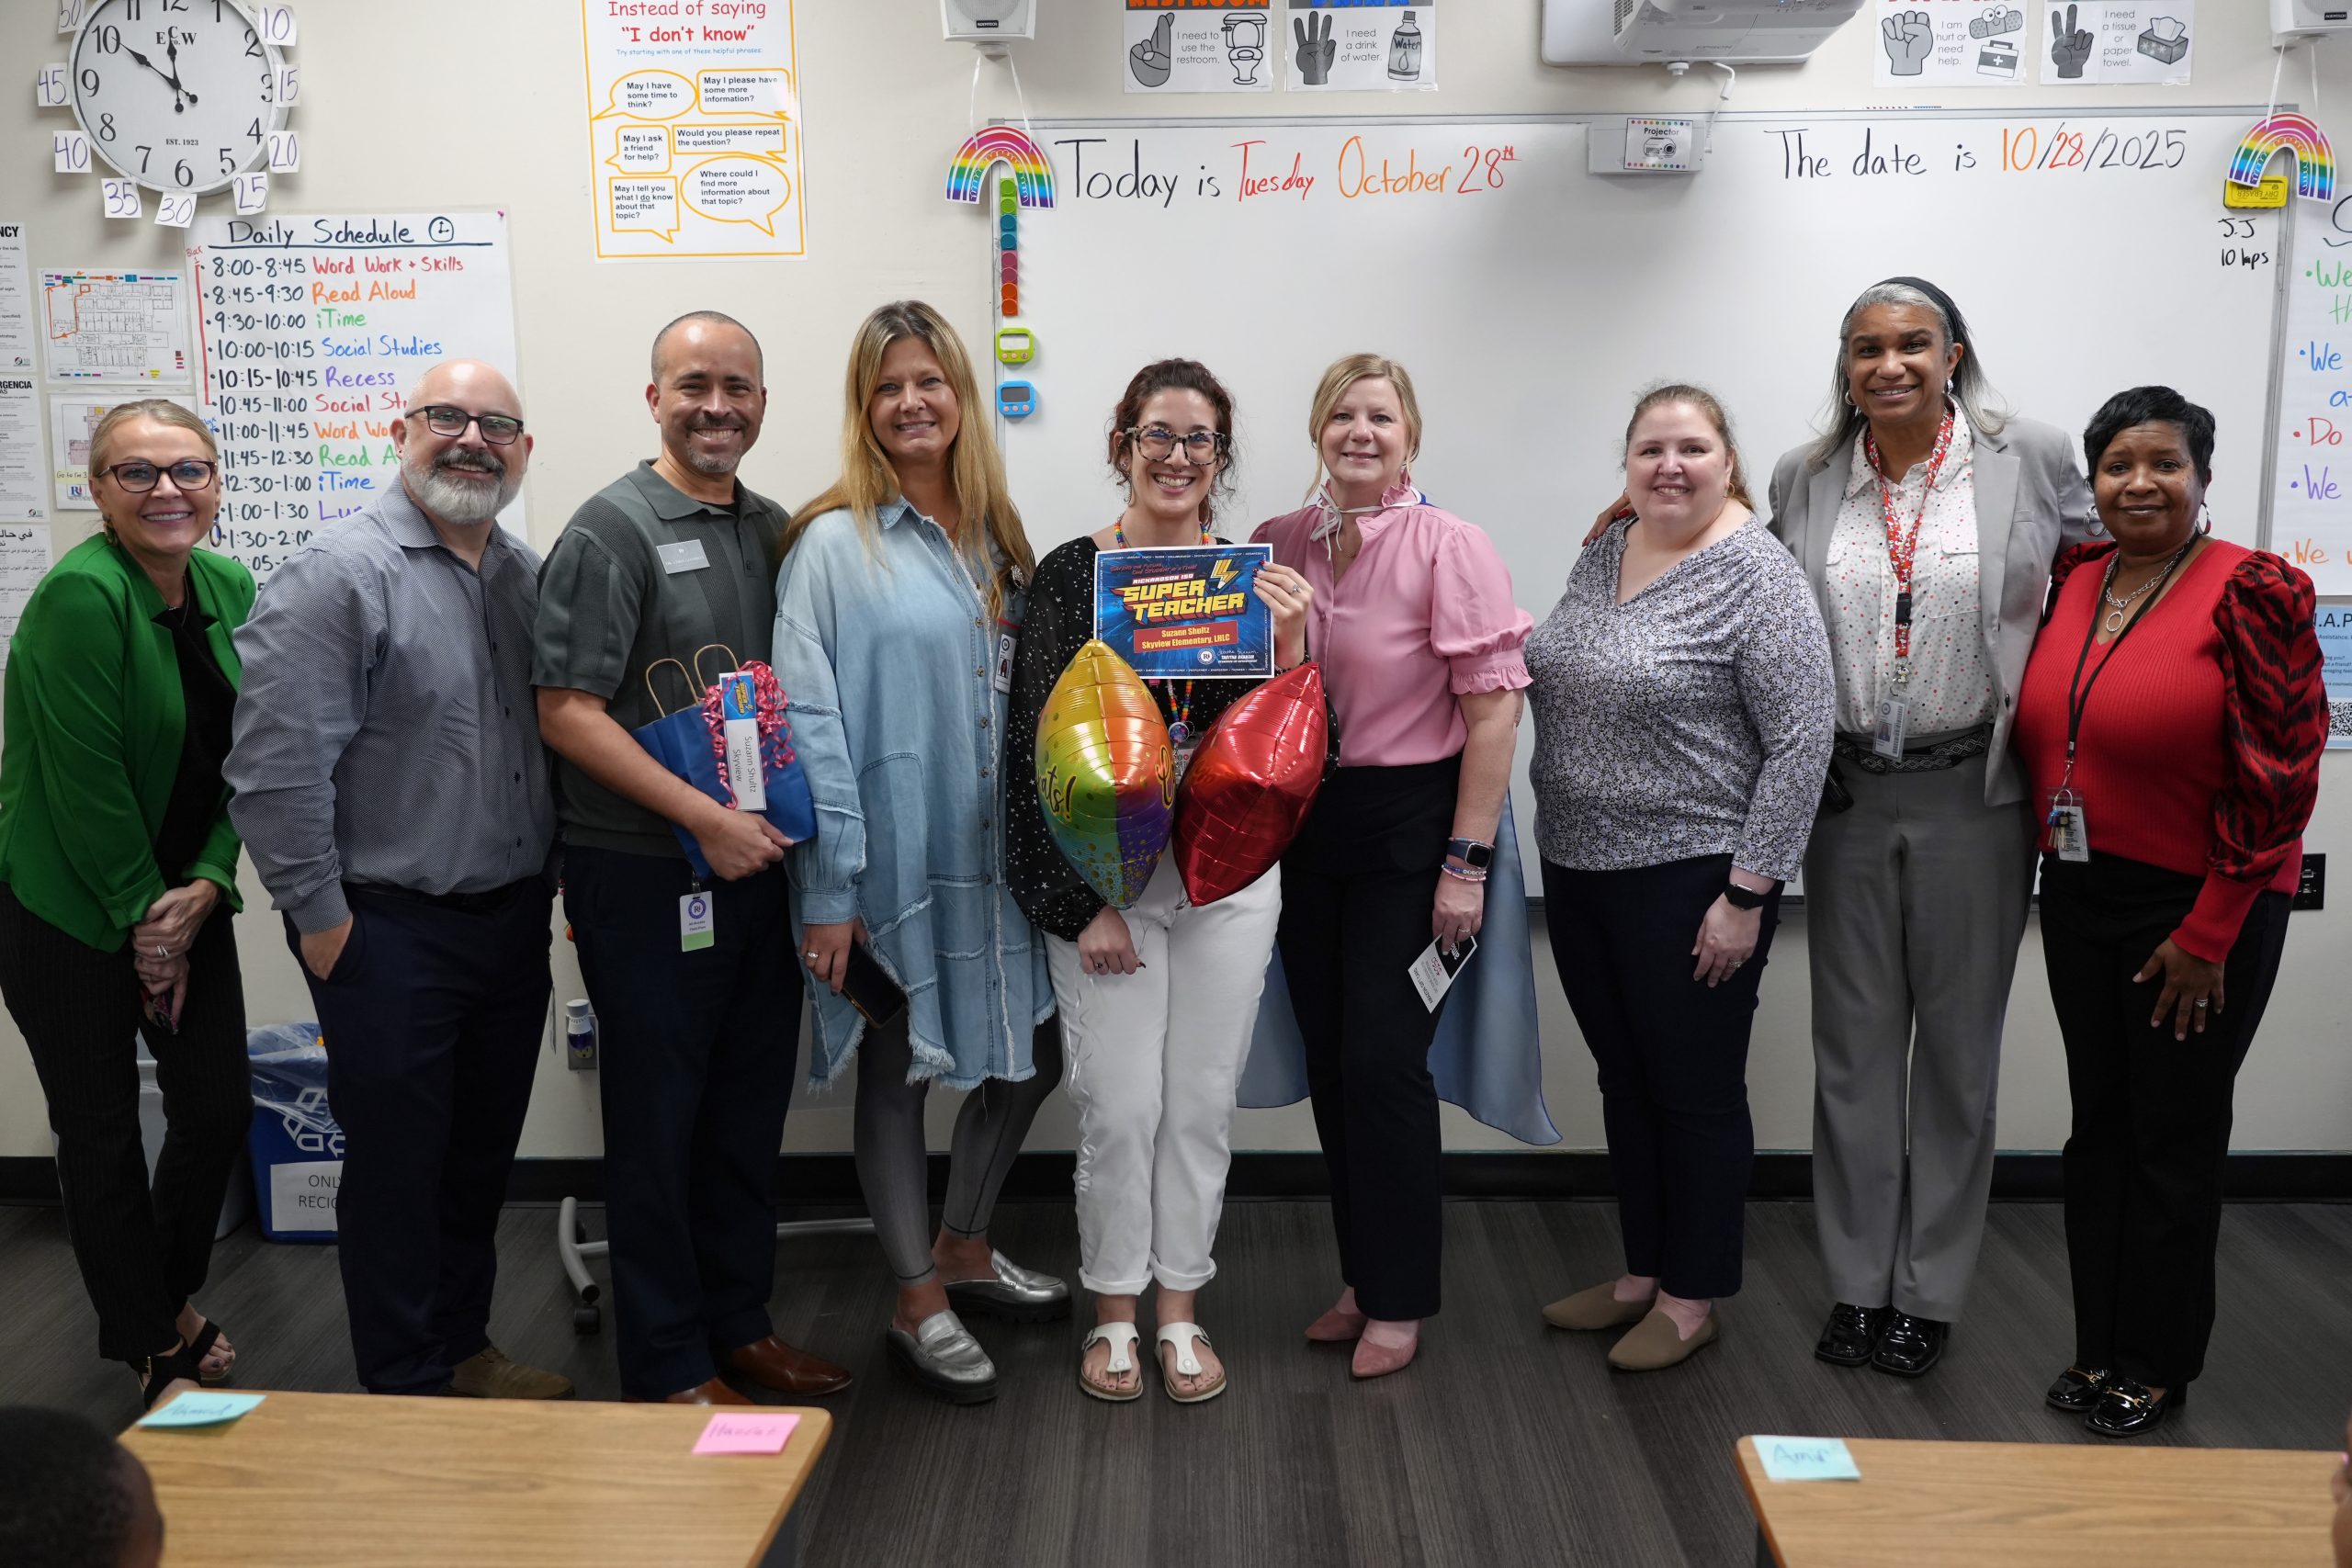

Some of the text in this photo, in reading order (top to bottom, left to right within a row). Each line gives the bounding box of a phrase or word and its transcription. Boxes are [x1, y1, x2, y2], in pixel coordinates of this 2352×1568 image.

[608, 0, 766, 18] Instead of saying
[2110, 10, 2135, 19] need
[264, 7, 290, 40] 10
[1351, 28, 1377, 38] need
[2112, 22, 2137, 31] tissue
[92, 25, 121, 54] 10
[244, 28, 264, 58] 2
[650, 26, 695, 42] don't
[1182, 31, 1220, 40] need to
[1394, 37, 1422, 51] Water
[1936, 32, 1955, 41] hurt
[2113, 35, 2123, 43] or
[629, 48, 655, 56] starting
[713, 47, 735, 56] helpful
[1182, 43, 1216, 52] use the
[1355, 40, 1378, 51] drink
[1938, 44, 1963, 53] need
[2103, 47, 2132, 58] paper
[1177, 54, 1220, 64] restroom.
[1340, 52, 1383, 62] of water.
[1938, 57, 1962, 67] help.
[2103, 57, 2132, 67] towel.
[38, 69, 67, 105] 45
[81, 69, 100, 97] 9
[279, 69, 299, 103] 15
[627, 83, 644, 91] May
[704, 76, 721, 85] May
[729, 76, 756, 85] please
[628, 100, 652, 108] think?
[705, 95, 754, 103] information?
[99, 113, 117, 141] 8
[246, 118, 264, 146] 4
[707, 130, 723, 139] you
[725, 129, 752, 137] please
[755, 129, 780, 137] repeat
[1644, 127, 1679, 138] Projector
[183, 139, 199, 147] 1923
[623, 135, 640, 143] May
[692, 139, 731, 147] question?
[53, 135, 89, 170] 40
[135, 145, 152, 174] 7
[269, 133, 299, 168] 20
[637, 152, 660, 162] help?
[1763, 122, 2187, 180] The date is 10/28/2025
[220, 148, 236, 176] 5
[1054, 135, 1453, 209] Today is Tuesday October
[175, 159, 194, 187] 6
[700, 179, 716, 187] find
[104, 182, 139, 216] 35
[233, 176, 267, 210] 25
[615, 185, 630, 193] May
[650, 186, 665, 194] you
[161, 197, 194, 224] 30
[639, 202, 655, 210] that
[718, 197, 743, 206] topic?
[616, 211, 640, 220] topic?
[228, 219, 415, 248] Daily Schedule
[212, 255, 464, 277] 8:00-8:45 Word Work Skills
[2222, 249, 2236, 266] 10
[212, 278, 416, 306] 8:45-9:30 Read Aloud
[214, 309, 368, 333] 9:30-10:00 iTime
[218, 334, 443, 360] 10:00-10:15 Social Studies
[2311, 341, 2343, 371] We
[220, 366, 396, 390] 10:15-10:45 Recess
[220, 392, 370, 416] 10:45-11:00 Social
[222, 421, 310, 443] 11:00-11:45
[313, 421, 360, 440] Word
[2308, 417, 2342, 446] Do
[223, 449, 313, 469] 11:45-12:30
[319, 444, 373, 467] Read
[225, 470, 375, 494] 12:30-1:00 iTime
[2304, 464, 2342, 501] We
[228, 502, 309, 522] 1:00-1:30
[2294, 537, 2330, 568] We
[1114, 579, 1206, 604] SUPER
[1128, 592, 1246, 622] TEACHER
[1141, 638, 1171, 649] Skyview
[1161, 629, 1187, 638] Suzann
[733, 749, 741, 783] Skyview
[744, 736, 758, 794] Suzann Shultz
